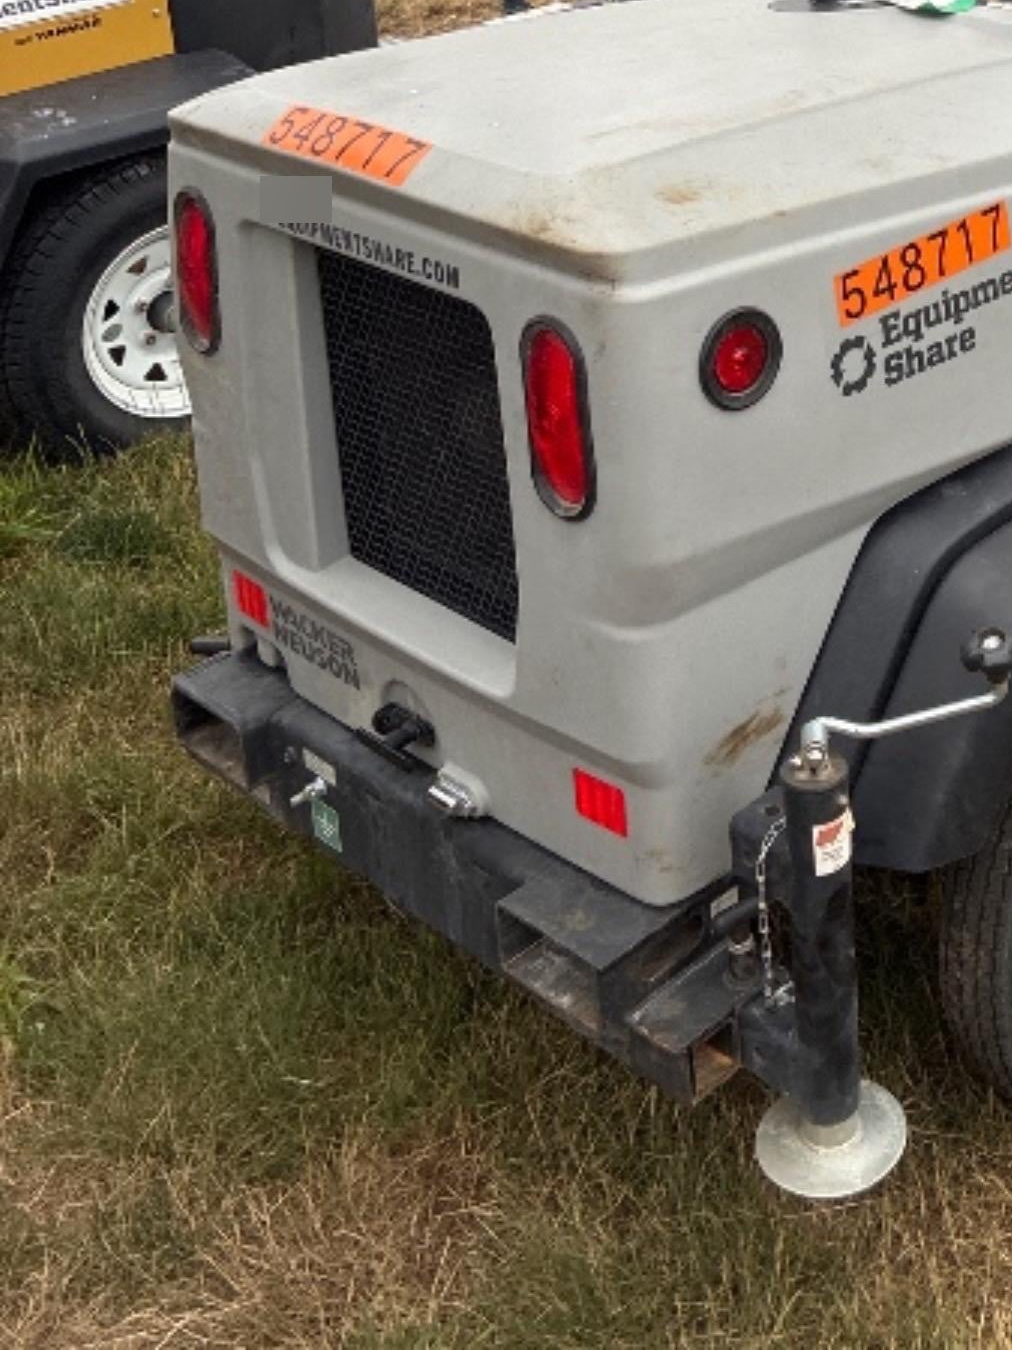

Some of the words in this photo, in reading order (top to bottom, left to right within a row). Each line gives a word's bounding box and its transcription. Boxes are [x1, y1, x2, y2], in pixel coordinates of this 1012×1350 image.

[269, 107, 427, 178] 548717
[278, 222, 460, 289] UIPMENTSHARE.COM
[840, 203, 1002, 320] 548717
[884, 326, 977, 387] Share
[269, 595, 358, 667] WACKER
[273, 620, 361, 691] NEUSON
